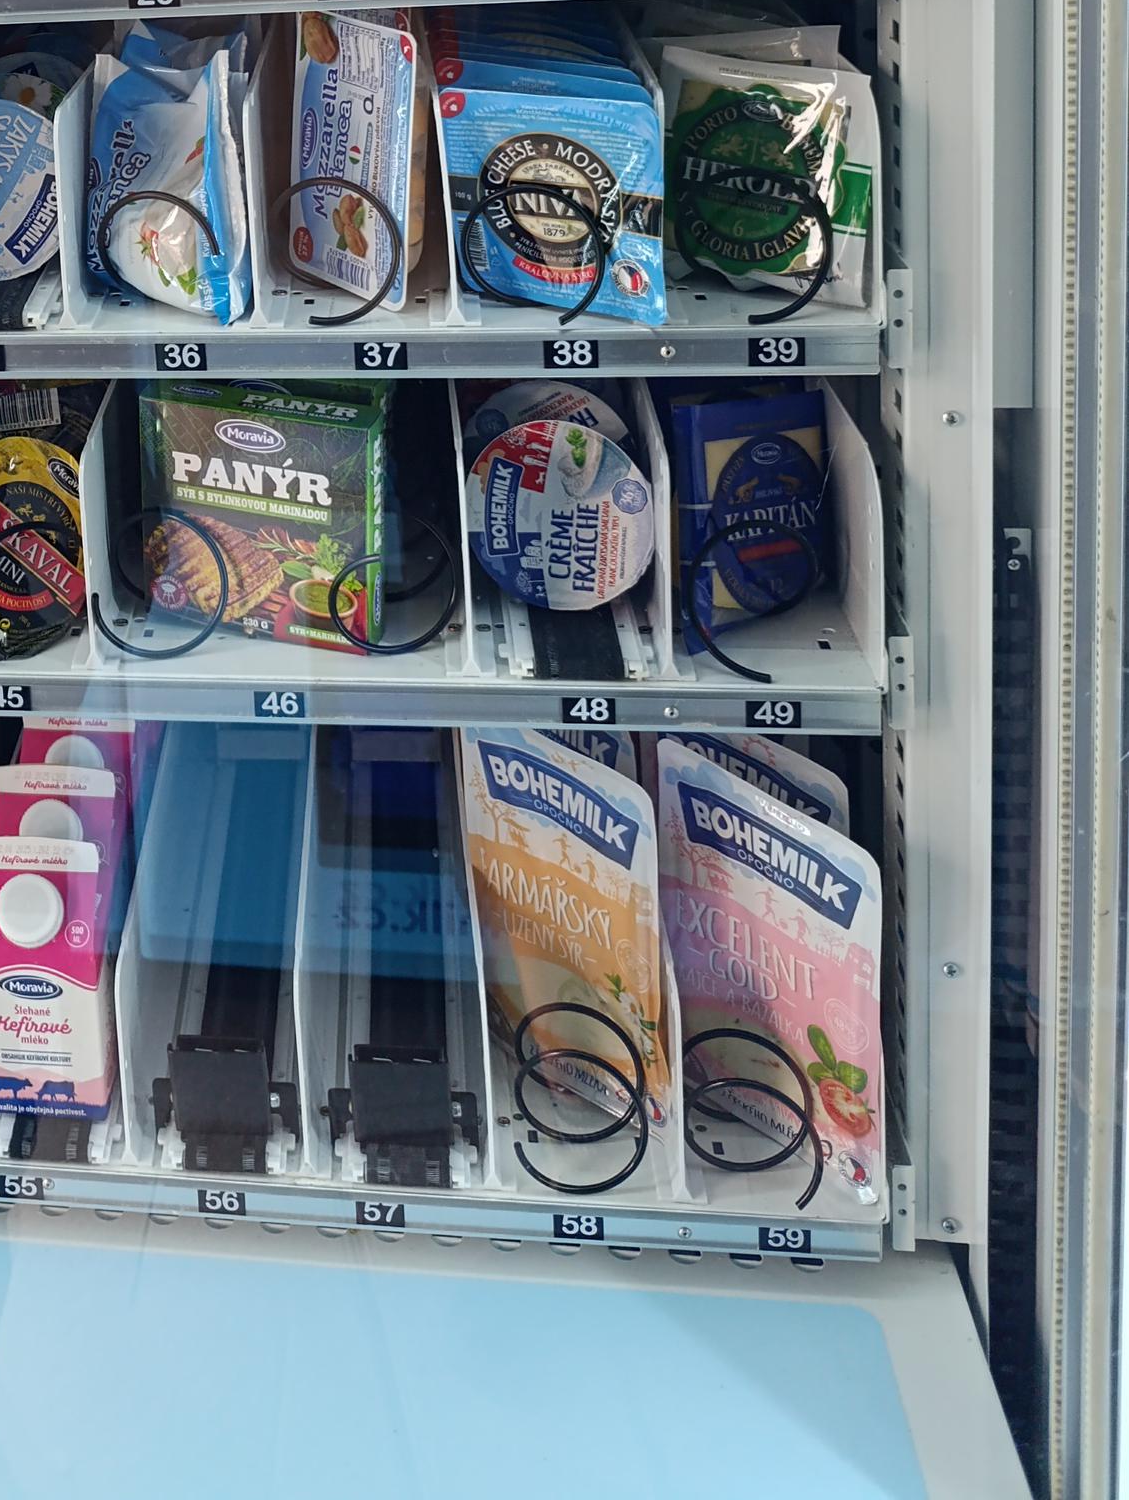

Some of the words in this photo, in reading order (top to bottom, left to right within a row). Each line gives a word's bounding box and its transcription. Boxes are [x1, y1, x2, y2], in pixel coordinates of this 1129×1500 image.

[301, 114, 313, 159] Moravia
[685, 107, 737, 150] PORTO
[487, 140, 536, 185] CHEESE
[543, 227, 566, 237] 1879
[691, 220, 750, 260] GLORIA
[163, 344, 201, 369] 36
[363, 343, 401, 367] 37
[553, 341, 593, 365] 38
[758, 338, 798, 363] 39
[226, 426, 275, 445] Moravia
[171, 450, 332, 506] PANÝR
[206, 491, 267, 512] BYLINKOVOU
[491, 463, 514, 550] BOHEMILK
[545, 509, 574, 580] CRÈME
[261, 692, 299, 715] 46
[570, 699, 610, 721] 48
[753, 702, 794, 725] 49
[487, 754, 628, 851] BOHEMILK
[534, 799, 583, 835] OPOČNO
[690, 796, 848, 912] BOHEMILK
[737, 850, 795, 890] OPOČNO
[676, 890, 816, 1000] EXCELENT
[709, 949, 779, 1002] GOLD
[9, 981, 54, 995] Moravia
[14, 1005, 51, 1017] Šlehané
[742, 995, 805, 1046] BAZALKA
[21, 1034, 49, 1045] mléko
[3, 1175, 38, 1197] 55
[204, 1191, 240, 1212] 56
[364, 1202, 397, 1223] 57
[562, 1215, 598, 1237] 58
[767, 1228, 805, 1249] 59
